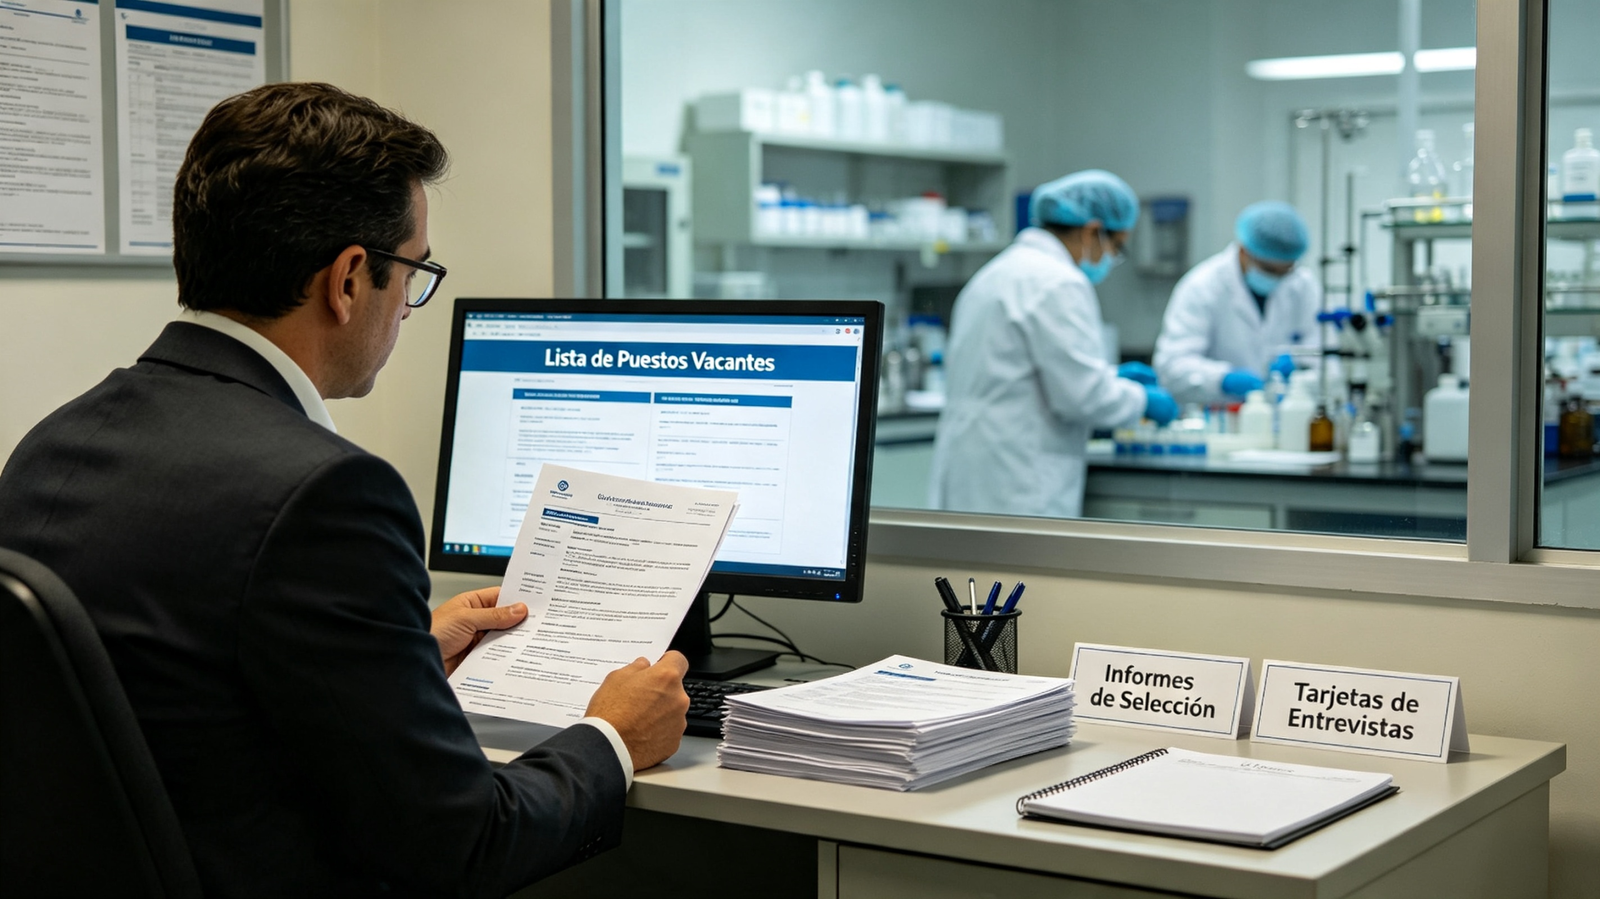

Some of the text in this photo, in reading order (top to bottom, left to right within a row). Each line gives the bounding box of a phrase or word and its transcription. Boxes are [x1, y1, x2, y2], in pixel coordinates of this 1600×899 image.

[544, 347, 776, 372] Lista de Puestos Vacantes
[1105, 664, 1195, 691] Informes
[1090, 686, 1216, 719] de Selección
[1294, 682, 1420, 714] Tarjetas de
[1287, 707, 1414, 740] Entrevistas
